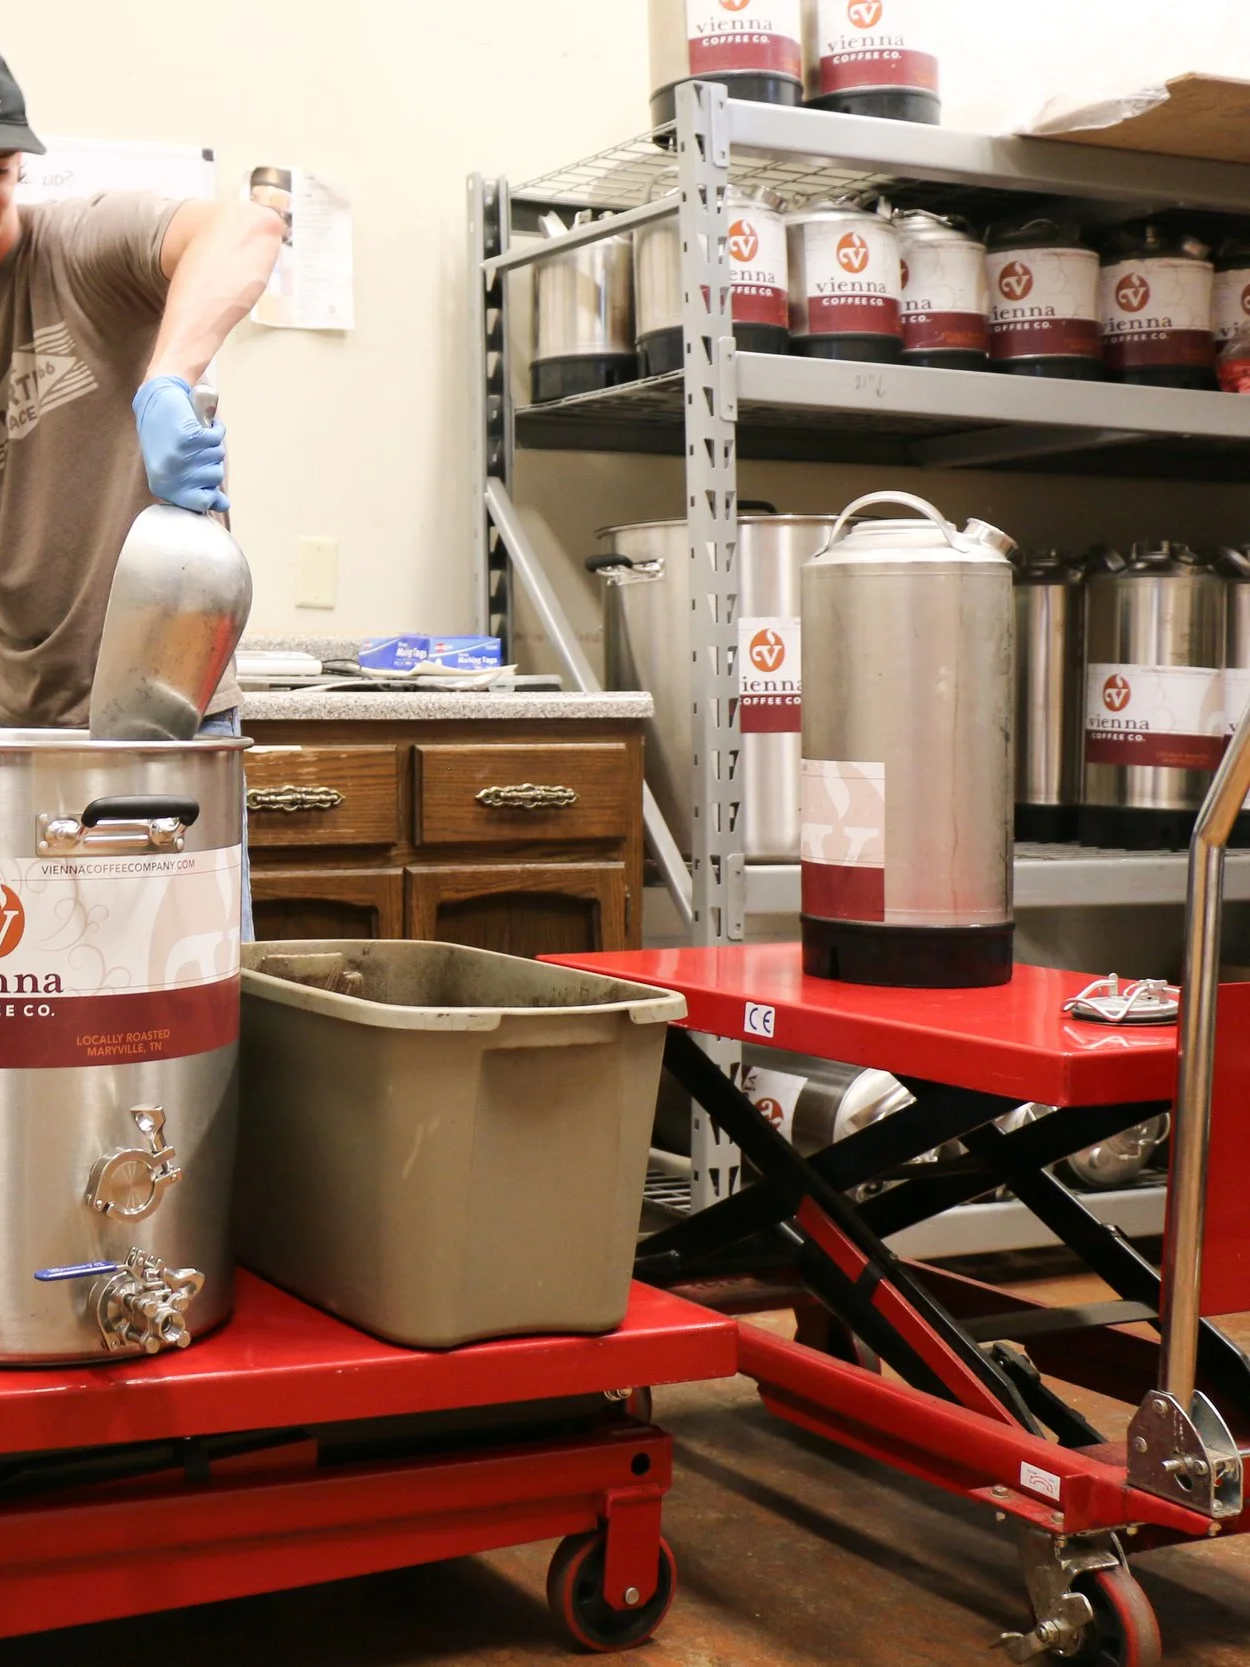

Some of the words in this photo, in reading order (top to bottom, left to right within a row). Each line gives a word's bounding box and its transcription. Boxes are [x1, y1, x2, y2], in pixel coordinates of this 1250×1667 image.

[696, 16, 773, 33] vienna
[702, 35, 750, 47] COFFEE
[752, 35, 770, 44] CO.
[827, 34, 904, 52] vienna
[833, 51, 880, 65] COFFEE
[883, 50, 902, 60] CO.
[730, 269, 775, 284] enna
[815, 277, 886, 294] vienna
[822, 297, 867, 307] COFFEE
[992, 305, 1056, 321] ienna
[994, 321, 1030, 333] OFFEE
[740, 696, 782, 706] OFFEE
[1089, 714, 1150, 730] vienna
[1091, 732, 1125, 741] COFFEE
[41, 859, 195, 875] VIENNACOFFEECOMPANY.COM
[23, 1003, 56, 1018] CO.
[76, 1033, 124, 1046] LOCALLY
[126, 1028, 170, 1042] ROASTED
[86, 1043, 147, 1057] MARYVILLE,
[149, 1041, 162, 1052] TN
